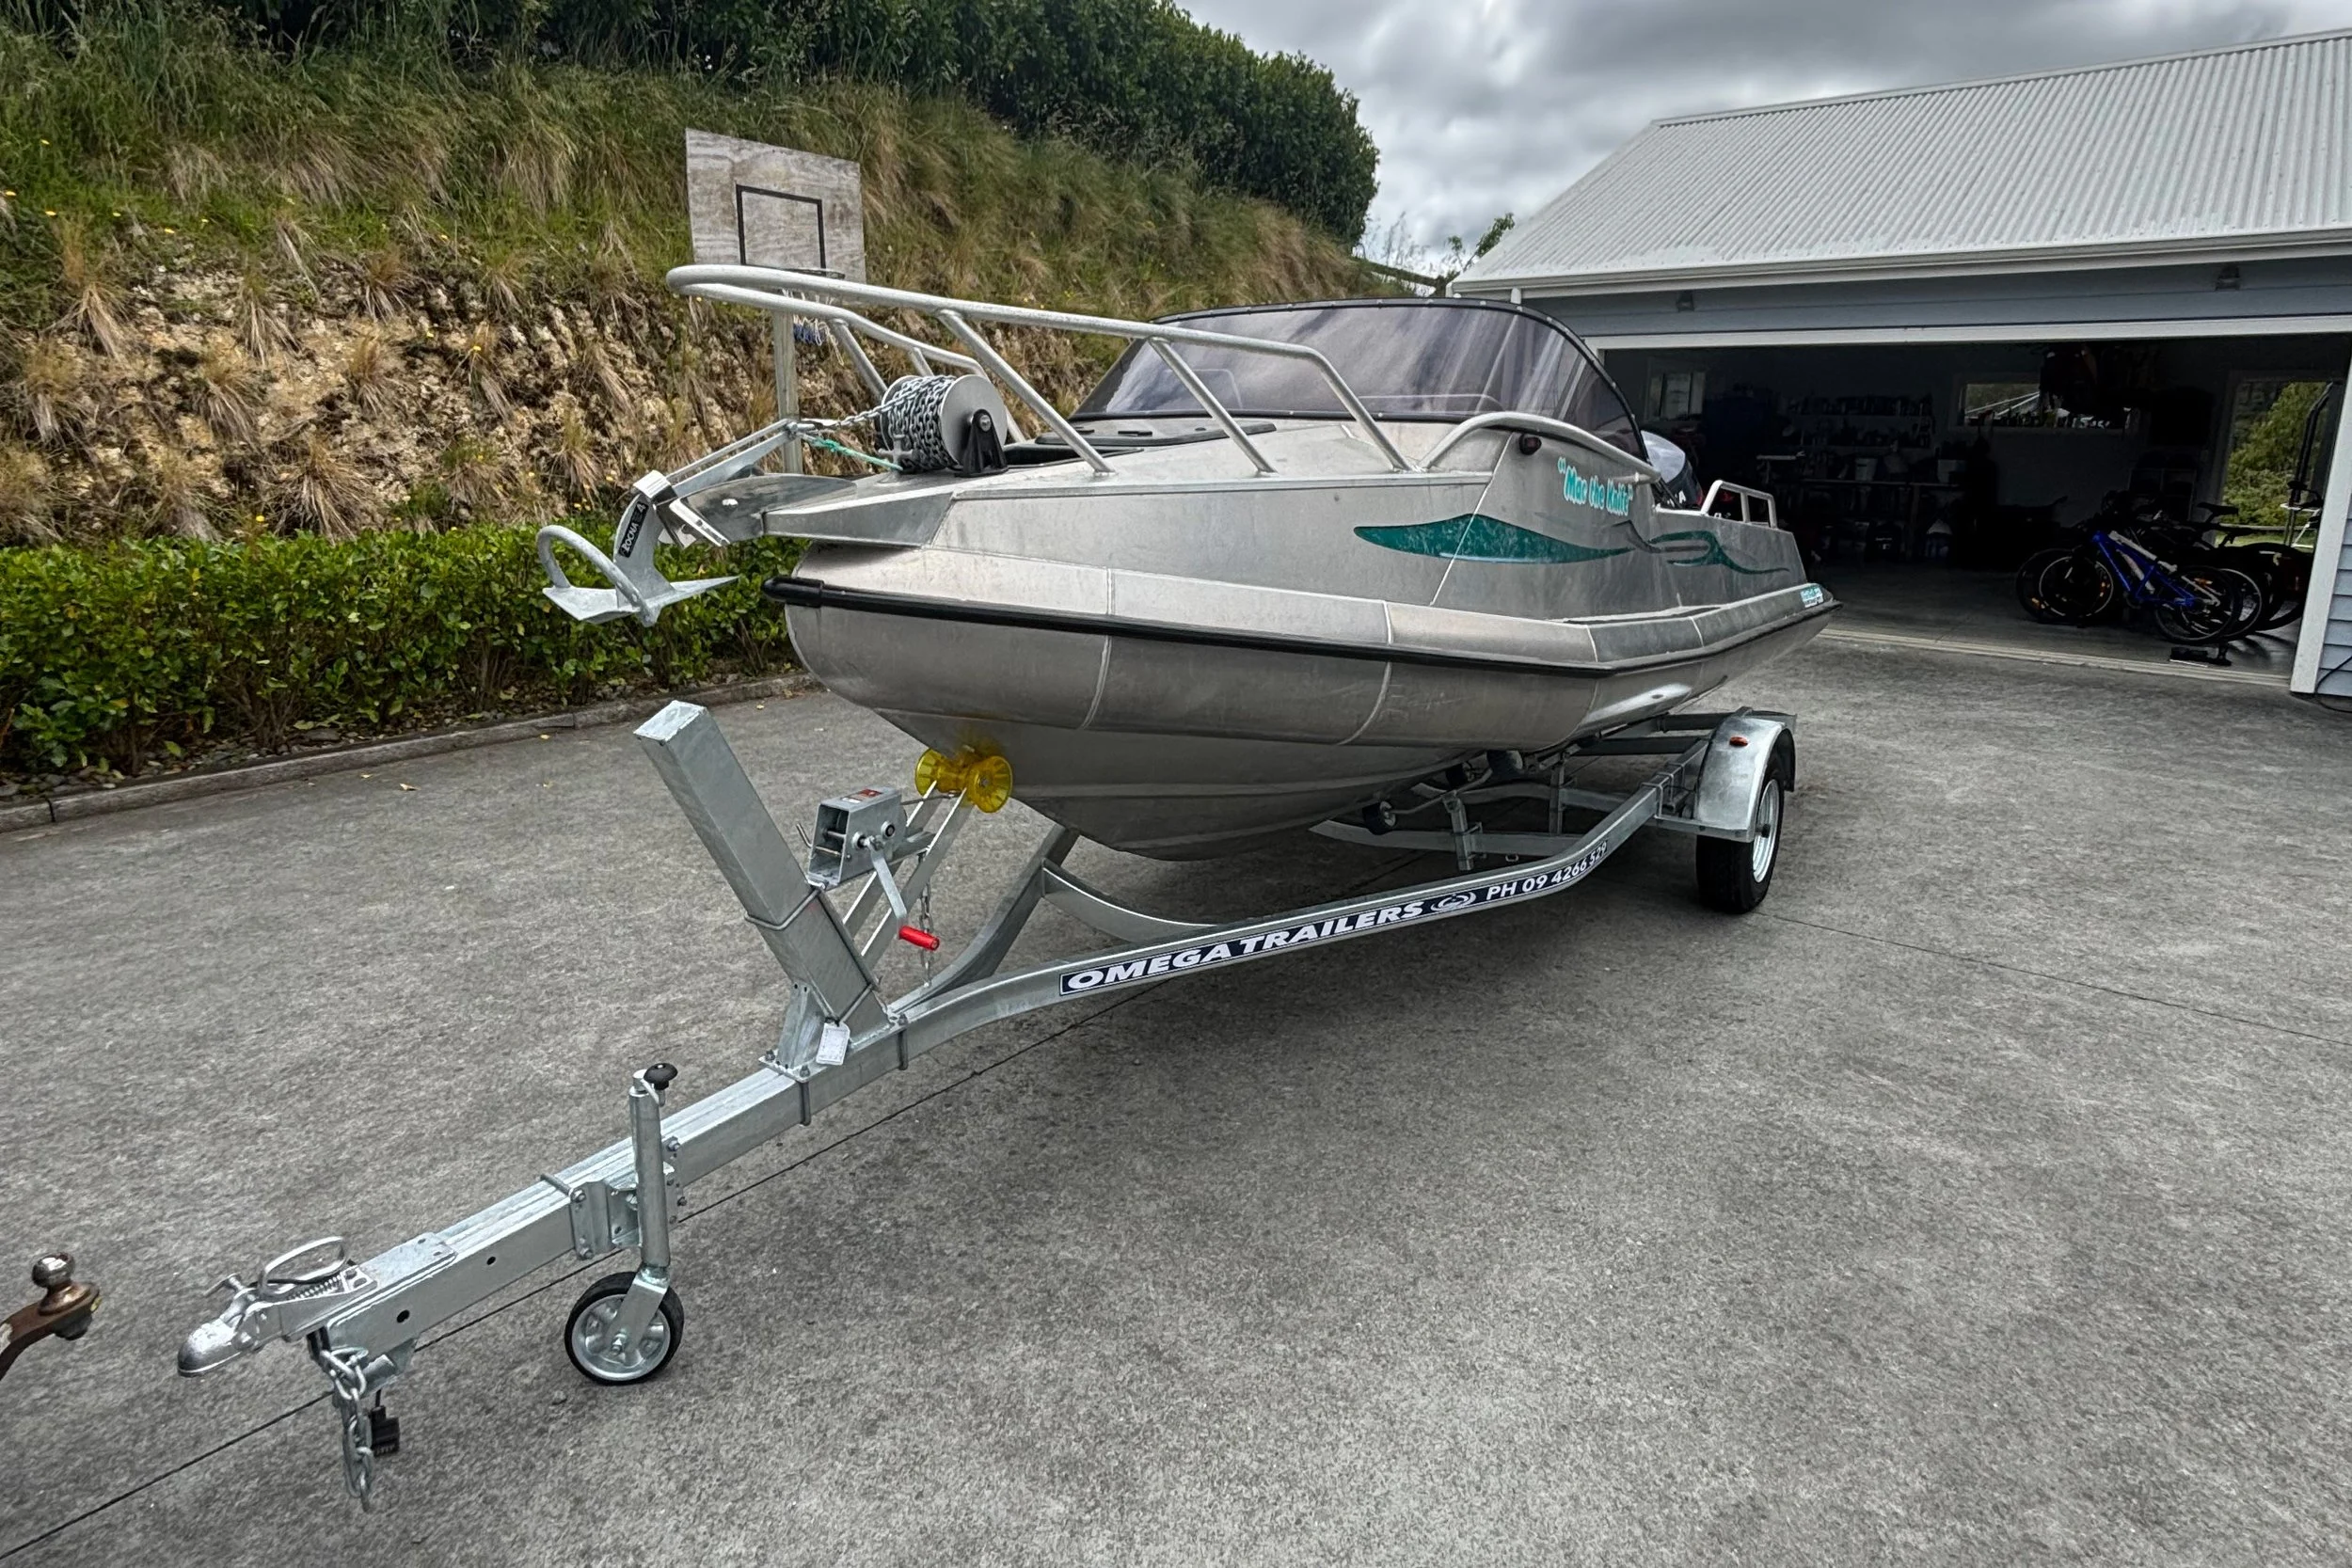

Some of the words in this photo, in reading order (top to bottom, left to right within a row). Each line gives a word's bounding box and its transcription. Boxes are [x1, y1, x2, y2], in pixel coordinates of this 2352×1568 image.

[637, 503, 646, 513] 4
[1589, 475, 1605, 509] the
[1068, 944, 1232, 990] OMEGA
[1240, 902, 1423, 954] TRAILERS
[1486, 881, 1517, 900] PH
[1522, 874, 1548, 892] 09
[1551, 858, 1587, 883] 4266
[1589, 841, 1607, 865] 529
